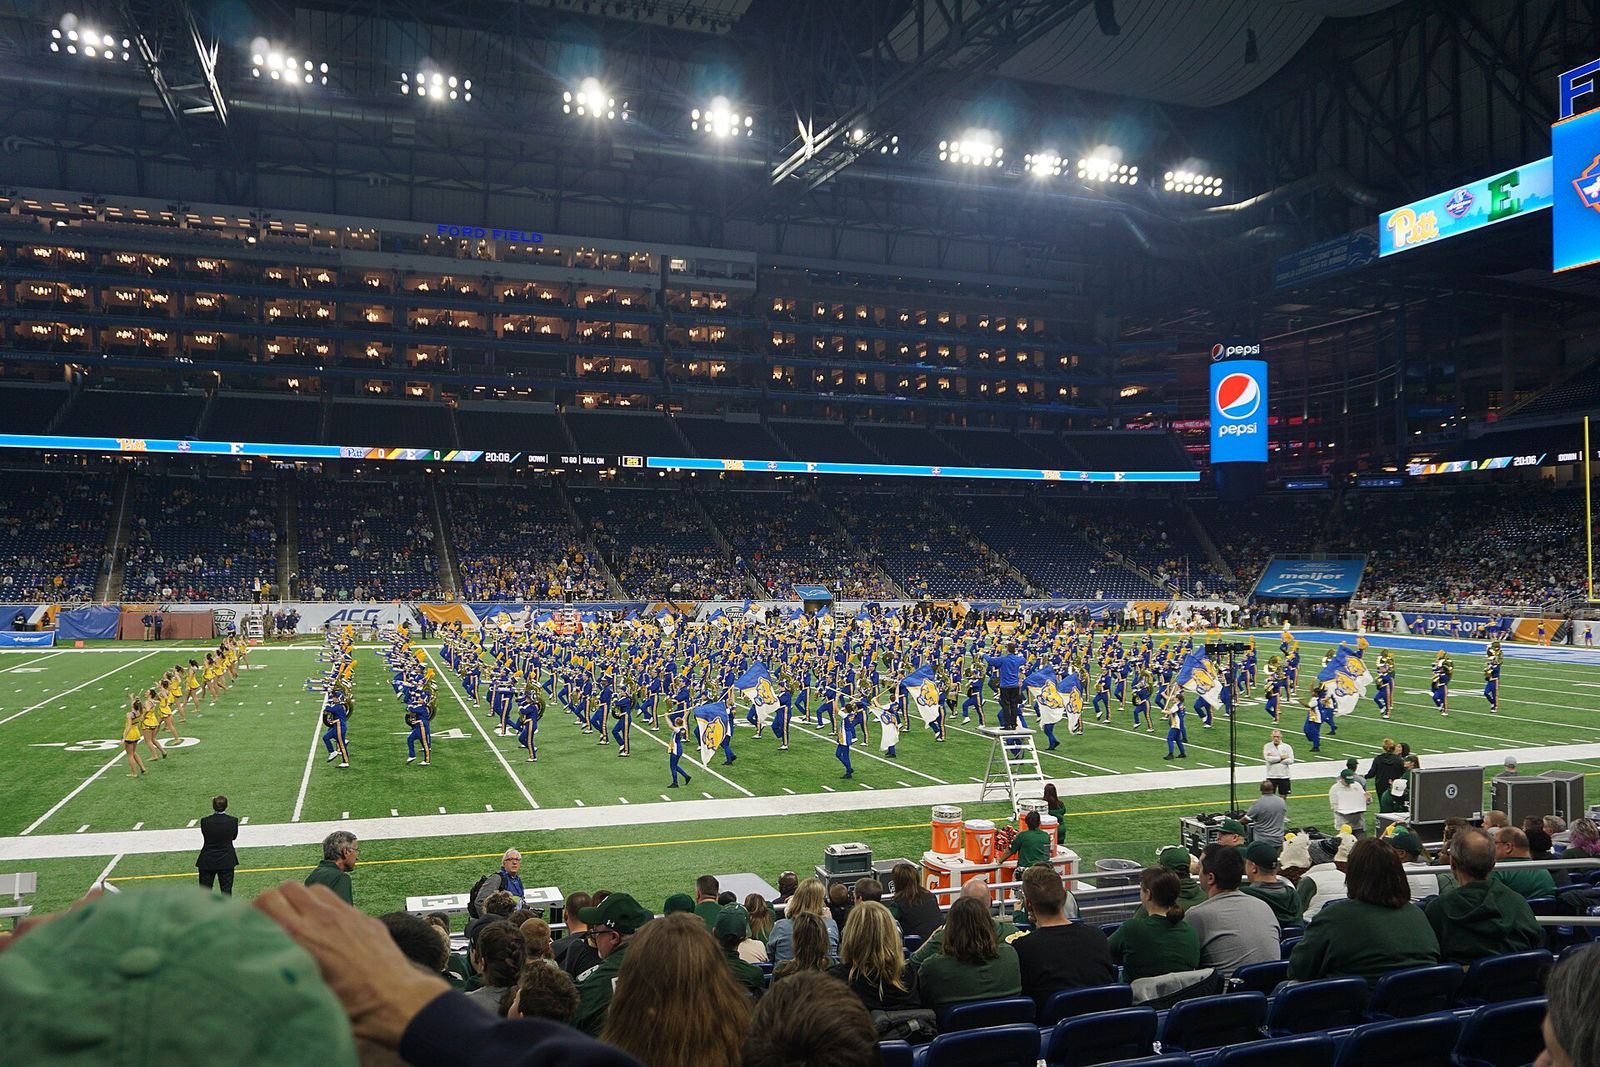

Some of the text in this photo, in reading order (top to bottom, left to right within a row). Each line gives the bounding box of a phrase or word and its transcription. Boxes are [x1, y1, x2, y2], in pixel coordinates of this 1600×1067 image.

[1488, 170, 1523, 222] E
[437, 224, 544, 243] FORD FIELD
[1387, 208, 1440, 248] Pitt
[1226, 343, 1260, 357] pepsi
[1219, 422, 1257, 438] pepsi
[347, 447, 363, 458] Pitt
[378, 449, 385, 459] 0
[406, 450, 416, 460] E
[434, 450, 441, 460] 0
[528, 455, 546, 463] DOWN
[1279, 572, 1345, 581] meijer
[327, 609, 381, 622] ACC
[1427, 619, 1486, 632] DETROIT
[949, 830, 958, 839] G
[982, 838, 990, 846] G
